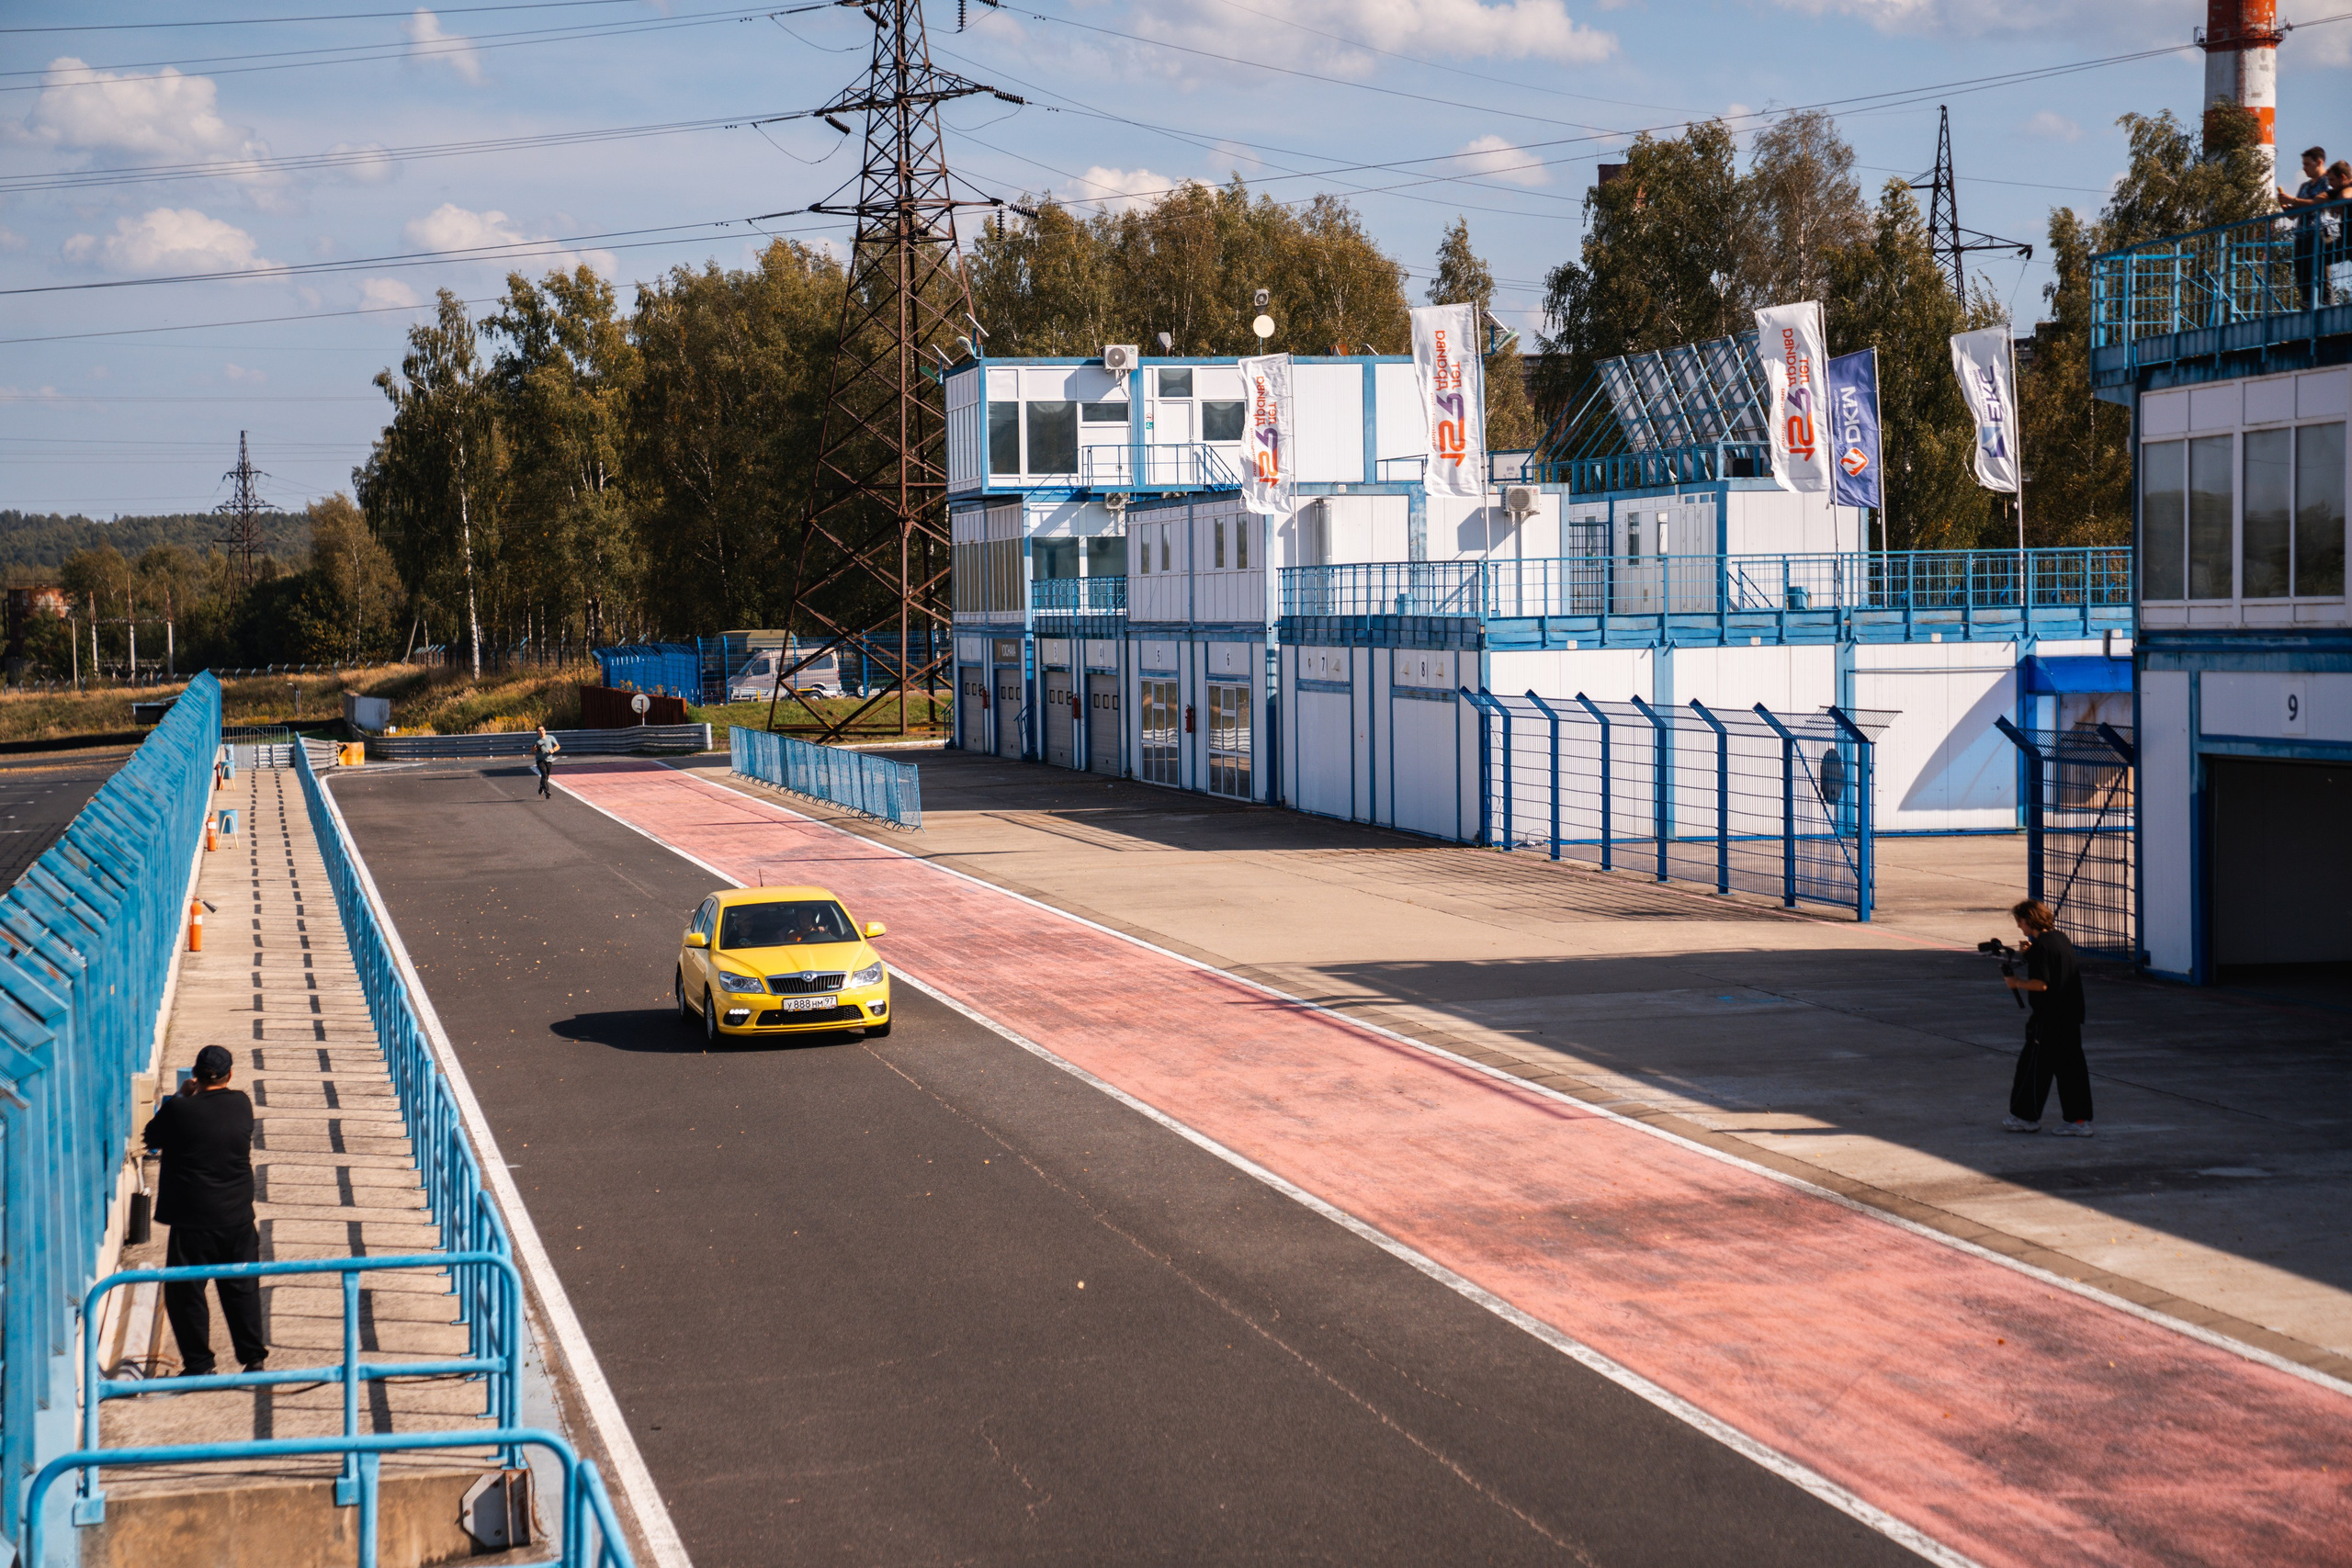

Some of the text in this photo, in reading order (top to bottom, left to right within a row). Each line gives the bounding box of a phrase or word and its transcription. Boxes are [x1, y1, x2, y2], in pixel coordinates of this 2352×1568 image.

[1227, 653, 1230, 666] 6
[1321, 657, 1325, 671] 7
[1421, 661, 1426, 677] 8
[2288, 694, 2299, 721] 9
